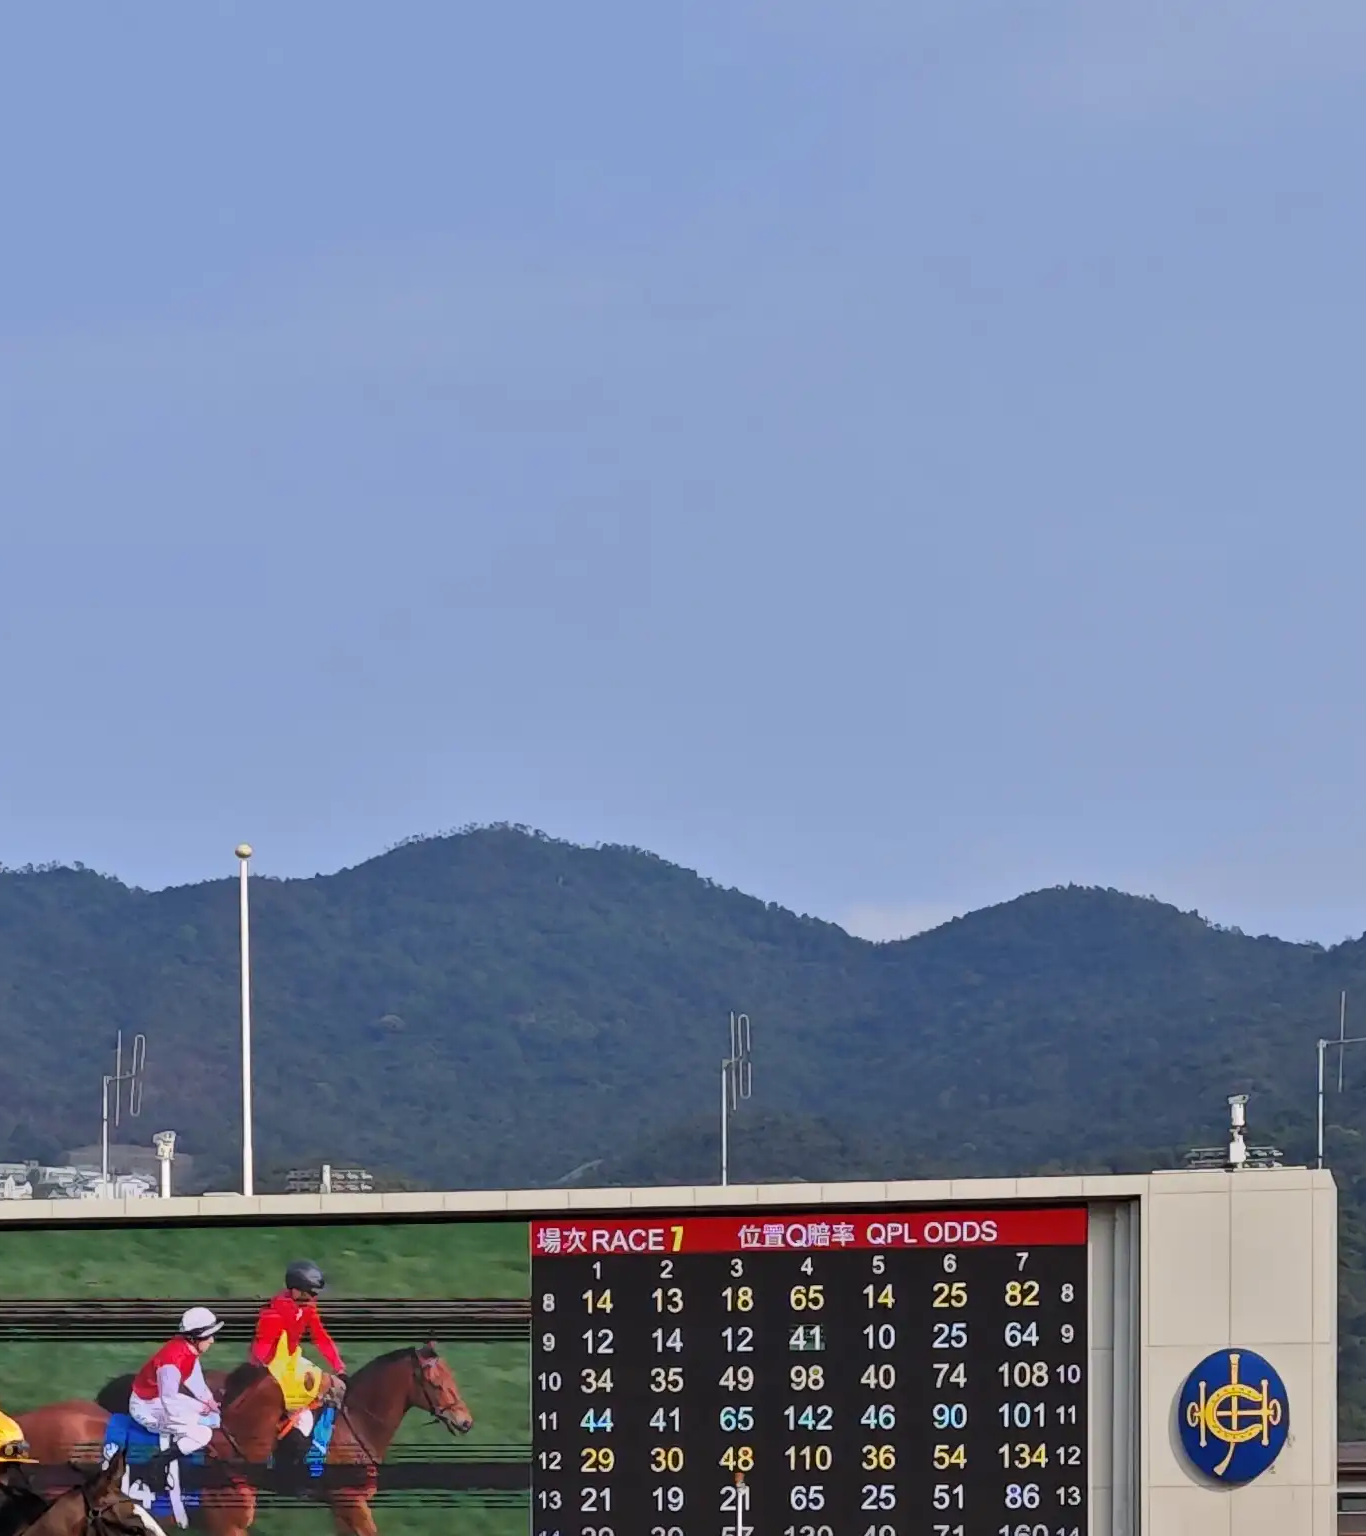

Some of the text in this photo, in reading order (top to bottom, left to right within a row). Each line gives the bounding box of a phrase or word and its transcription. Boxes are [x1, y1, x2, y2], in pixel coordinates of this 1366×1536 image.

[537, 1227, 587, 1253] 場次
[593, 1229, 664, 1252] RACE
[867, 1223, 917, 1244] QPL
[924, 1221, 997, 1242] ODDS
[593, 1252, 1028, 1279] 1 2 3 4 5 6 7
[543, 1281, 1073, 1313] 8 14 13 18 65 14 25 82 8
[543, 1322, 1073, 1353] 9 12 14 12 41 10 25 64 9
[538, 1362, 1080, 1393] 10 34 35 49 98 40 74 108 10
[539, 1403, 1075, 1432] 11 44 41 65 142 46 90 101 11
[539, 1443, 1080, 1472] 12 29 30 48 110 36 54 134 12
[539, 1491, 561, 1509] 13
[581, 1488, 610, 1511] 21
[653, 1487, 683, 1511] 19
[791, 1486, 824, 1510] 65
[861, 1485, 895, 1509] 25
[933, 1484, 963, 1509] 51
[1005, 1484, 1039, 1508] 86
[1056, 1486, 1081, 1505] 13
